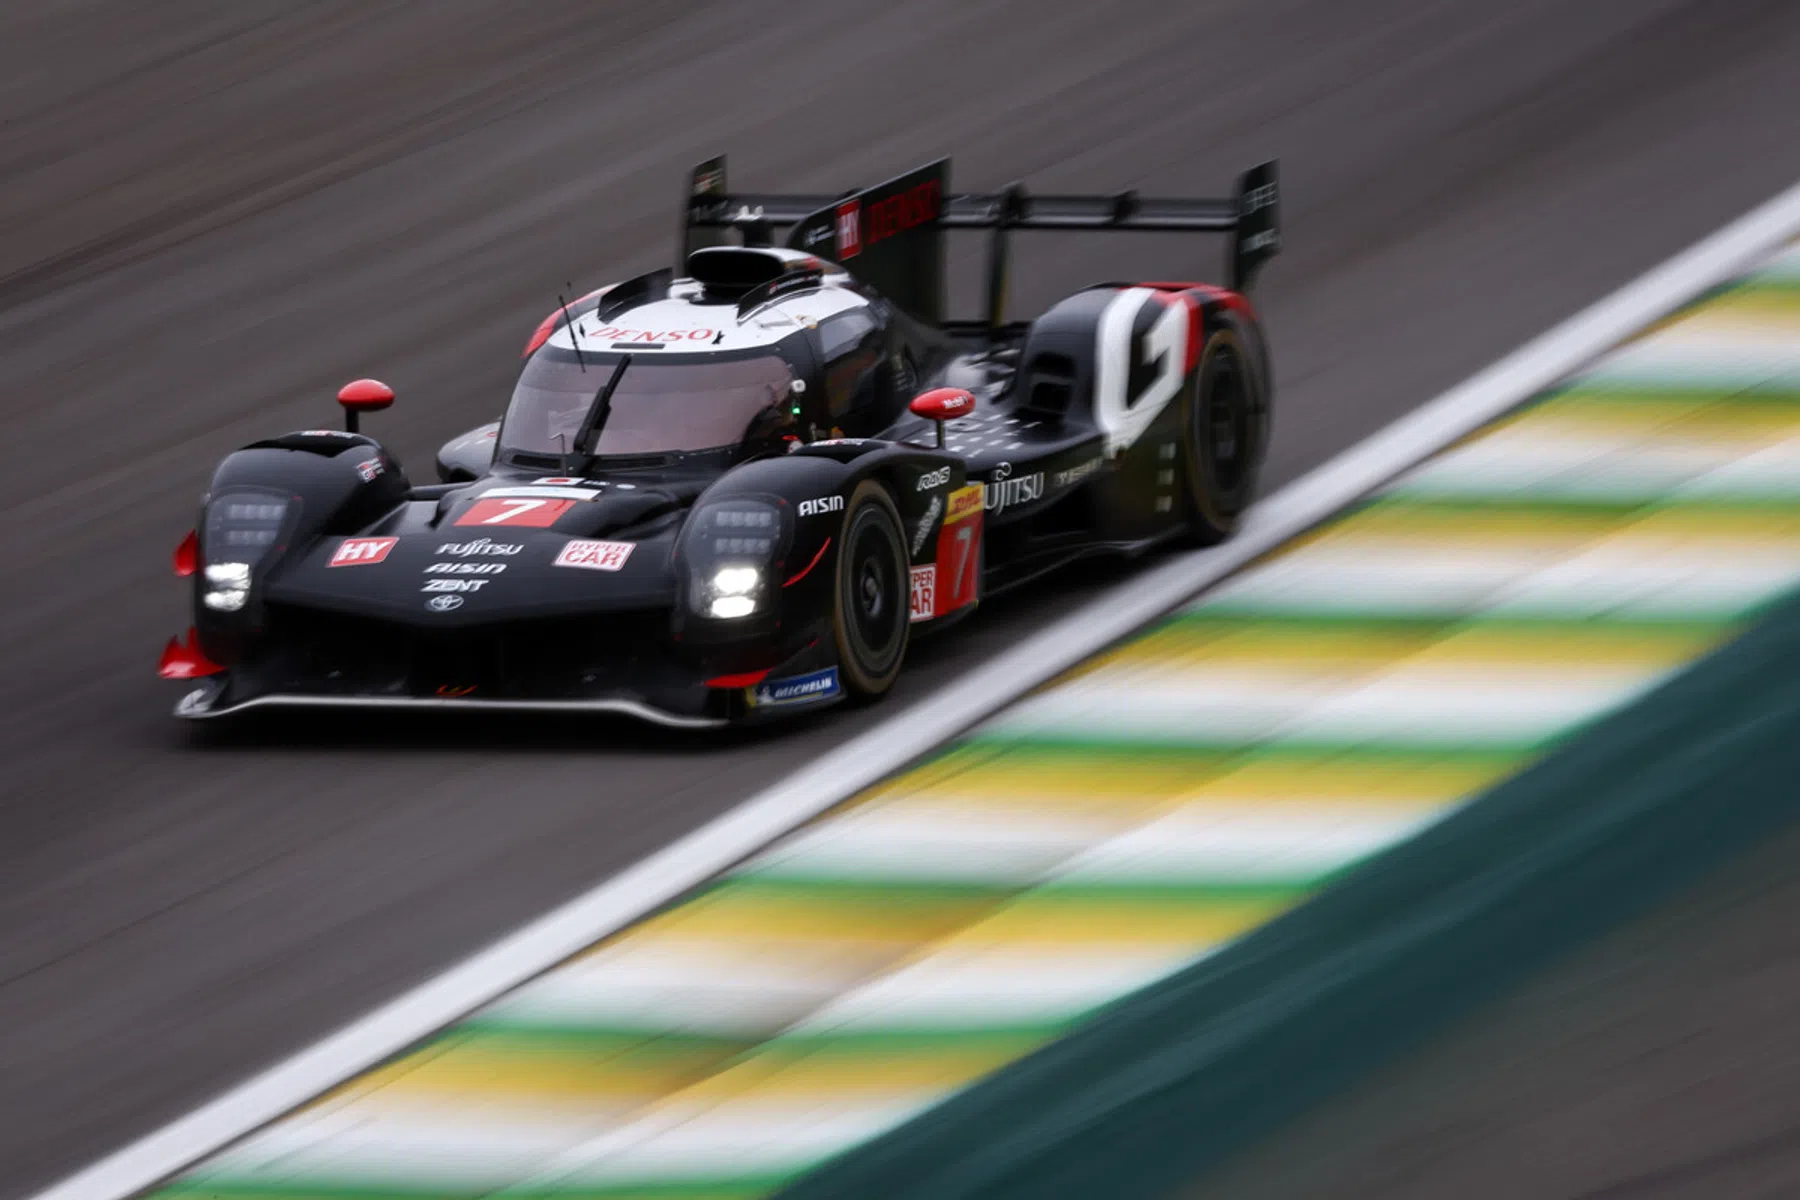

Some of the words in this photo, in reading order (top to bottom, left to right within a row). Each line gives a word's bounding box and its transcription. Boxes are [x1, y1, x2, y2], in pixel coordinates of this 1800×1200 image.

[588, 326, 713, 343] DENSO
[916, 465, 951, 492] RAYS
[984, 462, 1045, 516] UJITSU
[481, 499, 548, 525] 7
[797, 495, 845, 517] AISIN
[336, 541, 395, 561] HY
[434, 538, 525, 558] FUJITSU
[565, 550, 621, 566] CAR
[422, 562, 507, 575] AISIN
[953, 525, 973, 599] 7
[420, 578, 491, 593] ZENT
[911, 570, 933, 589] PER
[910, 588, 932, 615] AR
[774, 676, 833, 698] MICHELIN
